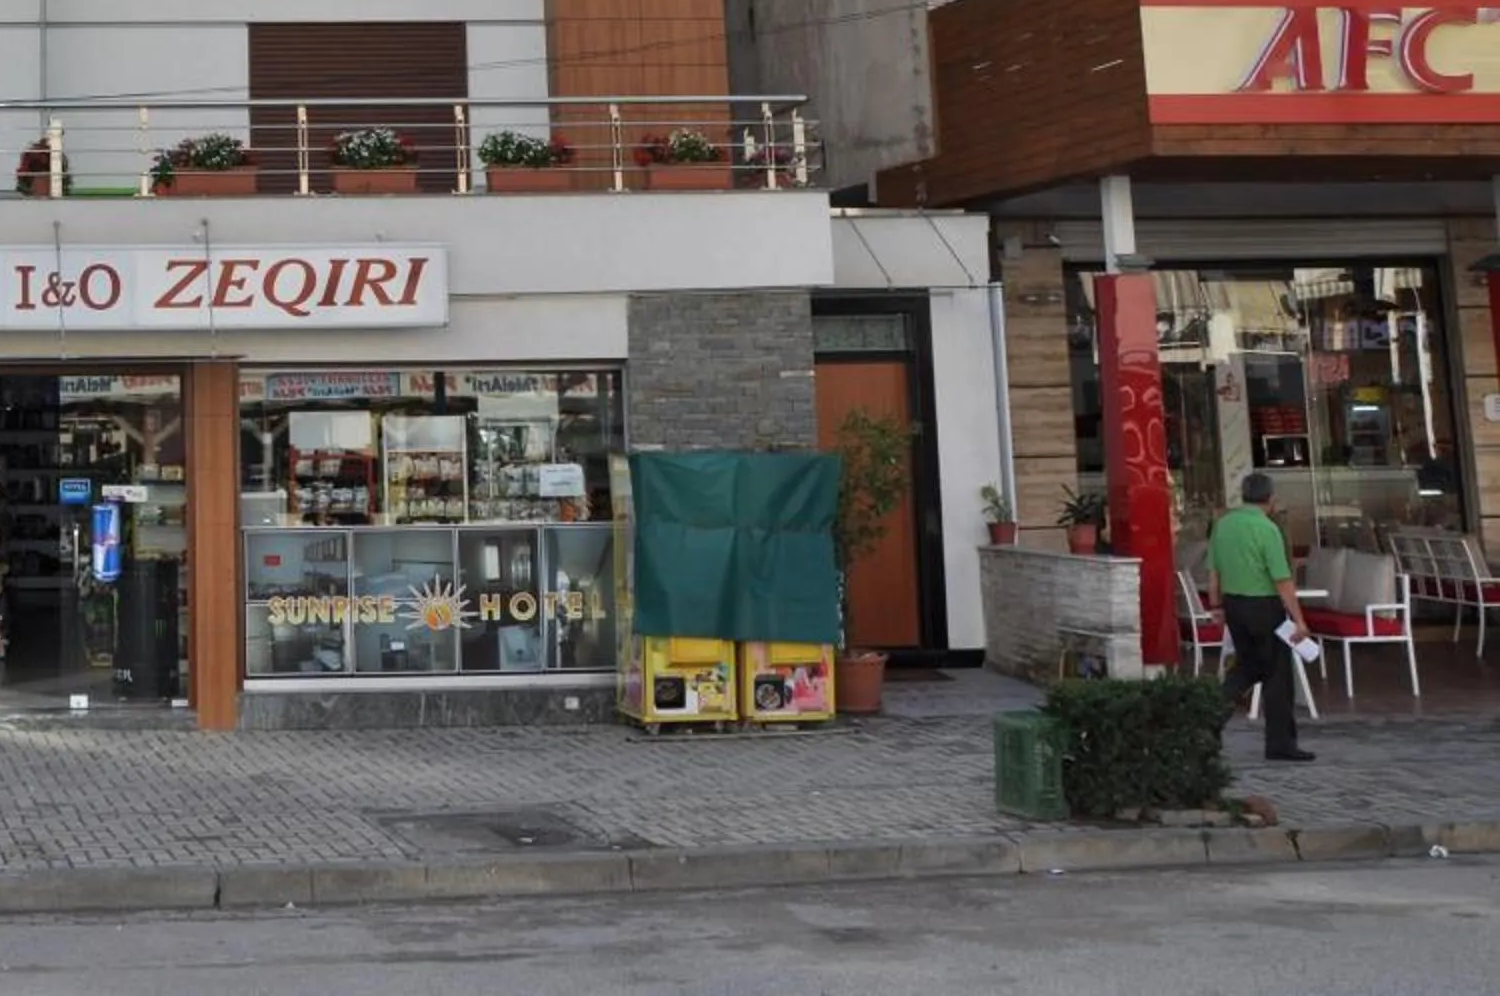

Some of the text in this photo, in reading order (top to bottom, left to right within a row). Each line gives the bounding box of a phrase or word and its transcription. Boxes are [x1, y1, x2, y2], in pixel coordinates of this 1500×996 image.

[1233, 5, 1478, 94] AFC
[14, 264, 122, 311] I&O
[154, 256, 430, 319] ZEQIRI
[267, 591, 607, 626] SUNRISE HOTEL
